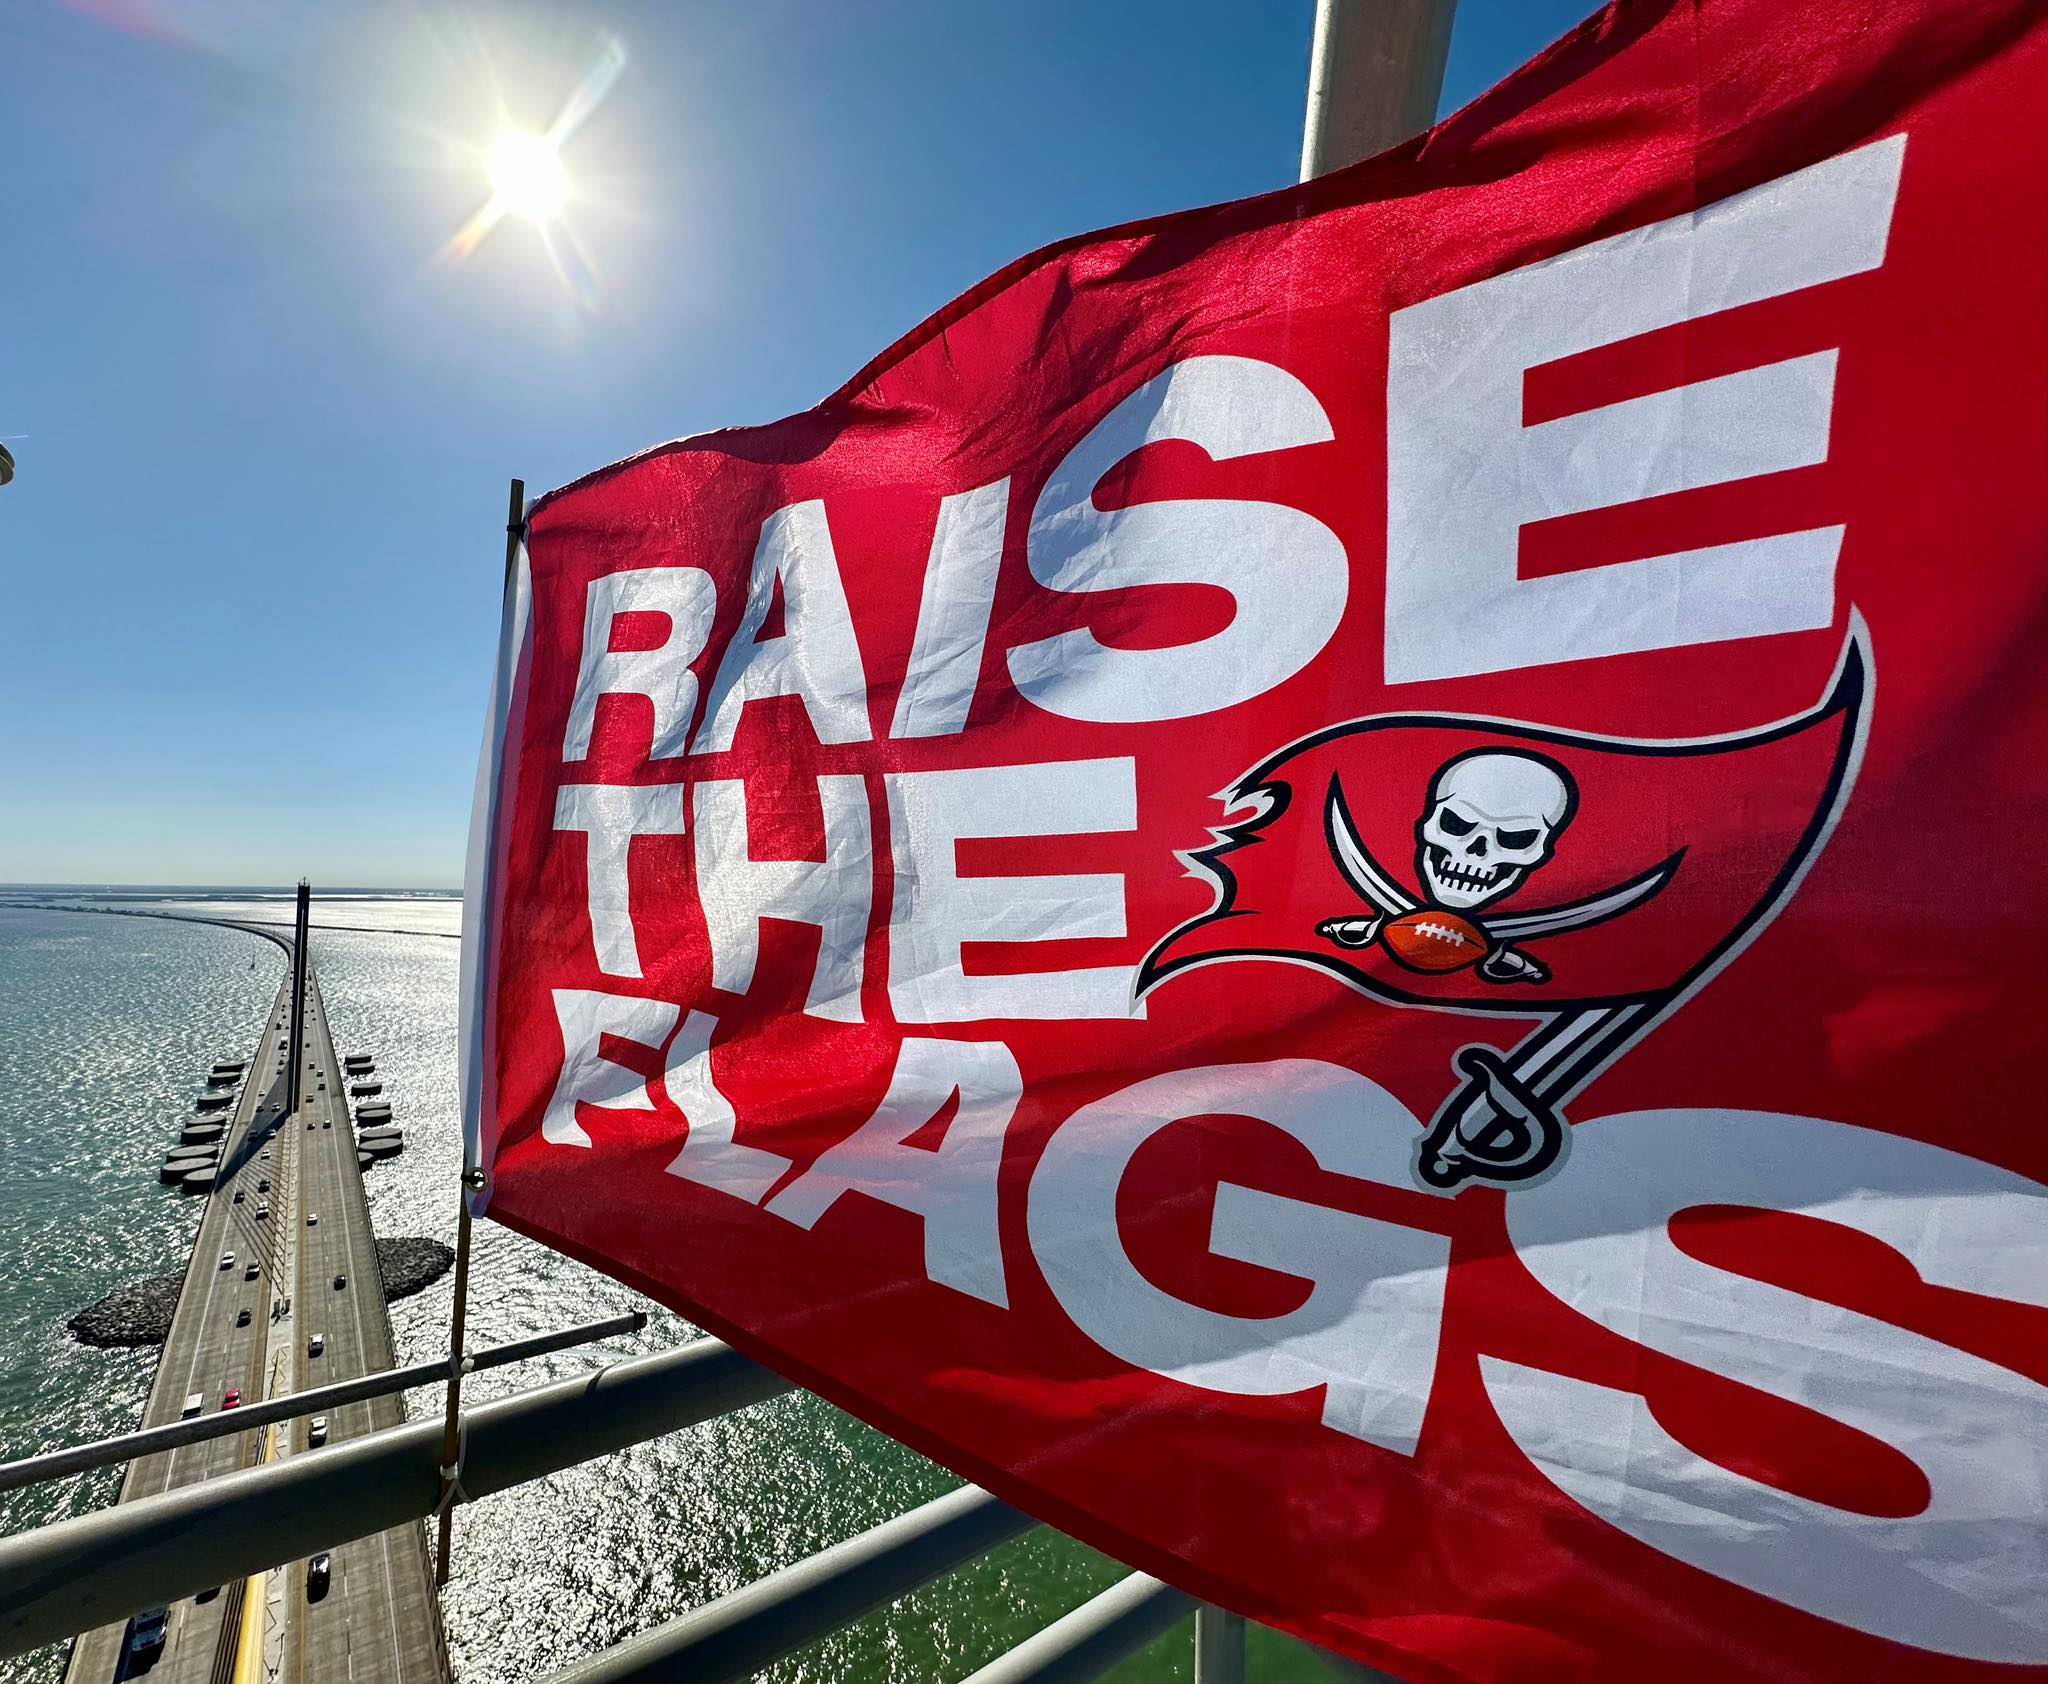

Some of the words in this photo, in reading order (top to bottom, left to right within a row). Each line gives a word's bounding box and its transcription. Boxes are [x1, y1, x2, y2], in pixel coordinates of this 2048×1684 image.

[563, 132, 1908, 762] RAISE
[553, 756, 1147, 1023] THE
[542, 988, 2048, 1666] FLAGS
